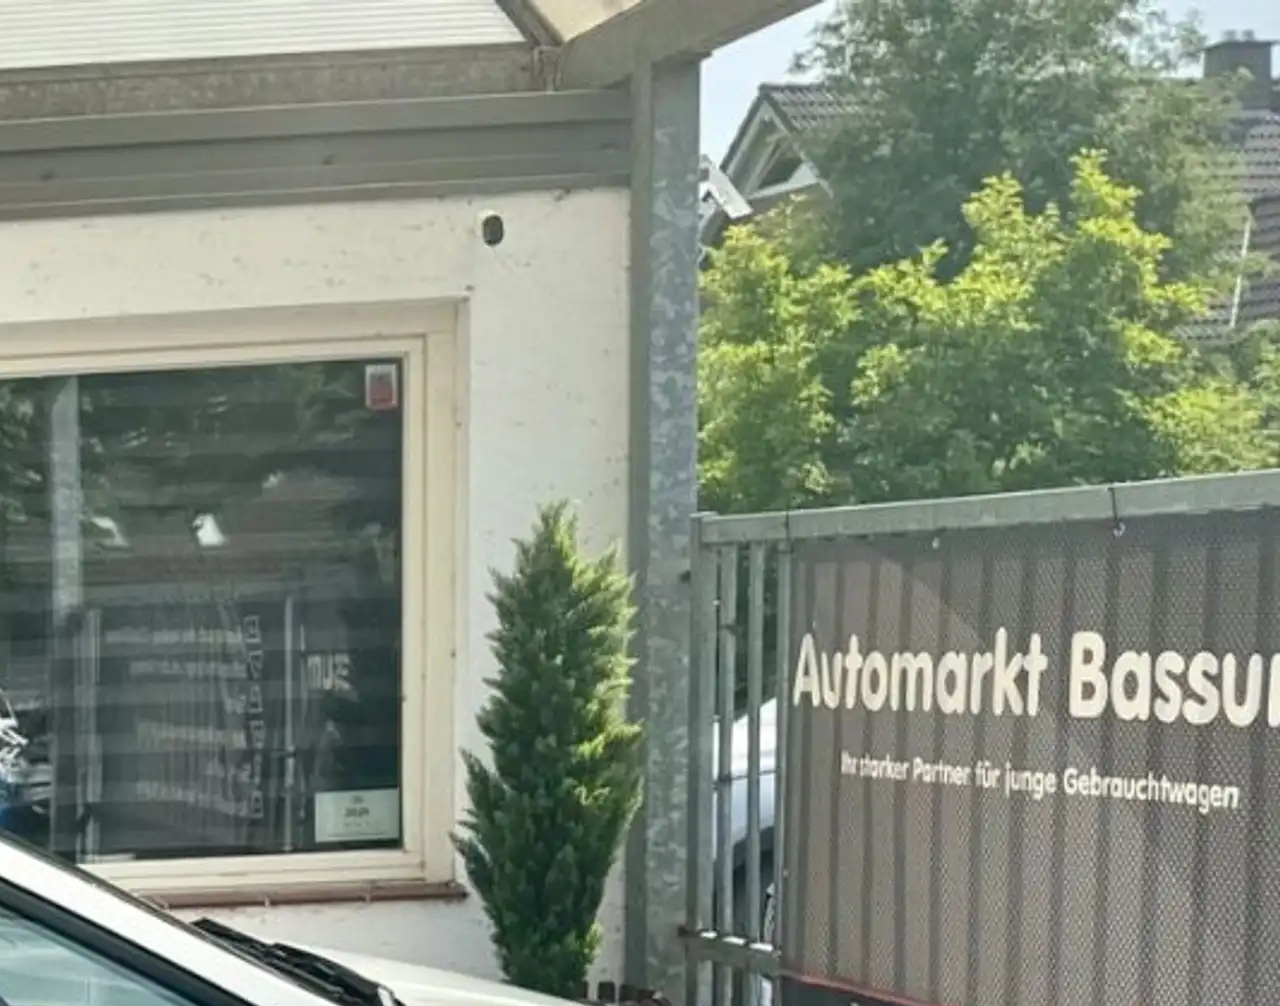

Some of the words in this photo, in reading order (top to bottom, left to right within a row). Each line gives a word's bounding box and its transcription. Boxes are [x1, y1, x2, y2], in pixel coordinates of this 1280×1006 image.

[793, 626, 1048, 716] Automarkt
[841, 751, 857, 776] Ihr
[860, 754, 909, 781] starker
[913, 756, 971, 786] Partner
[976, 759, 1001, 789] für
[1005, 761, 1057, 801] junge
[1064, 765, 1239, 813] Gebrauchtwagen
